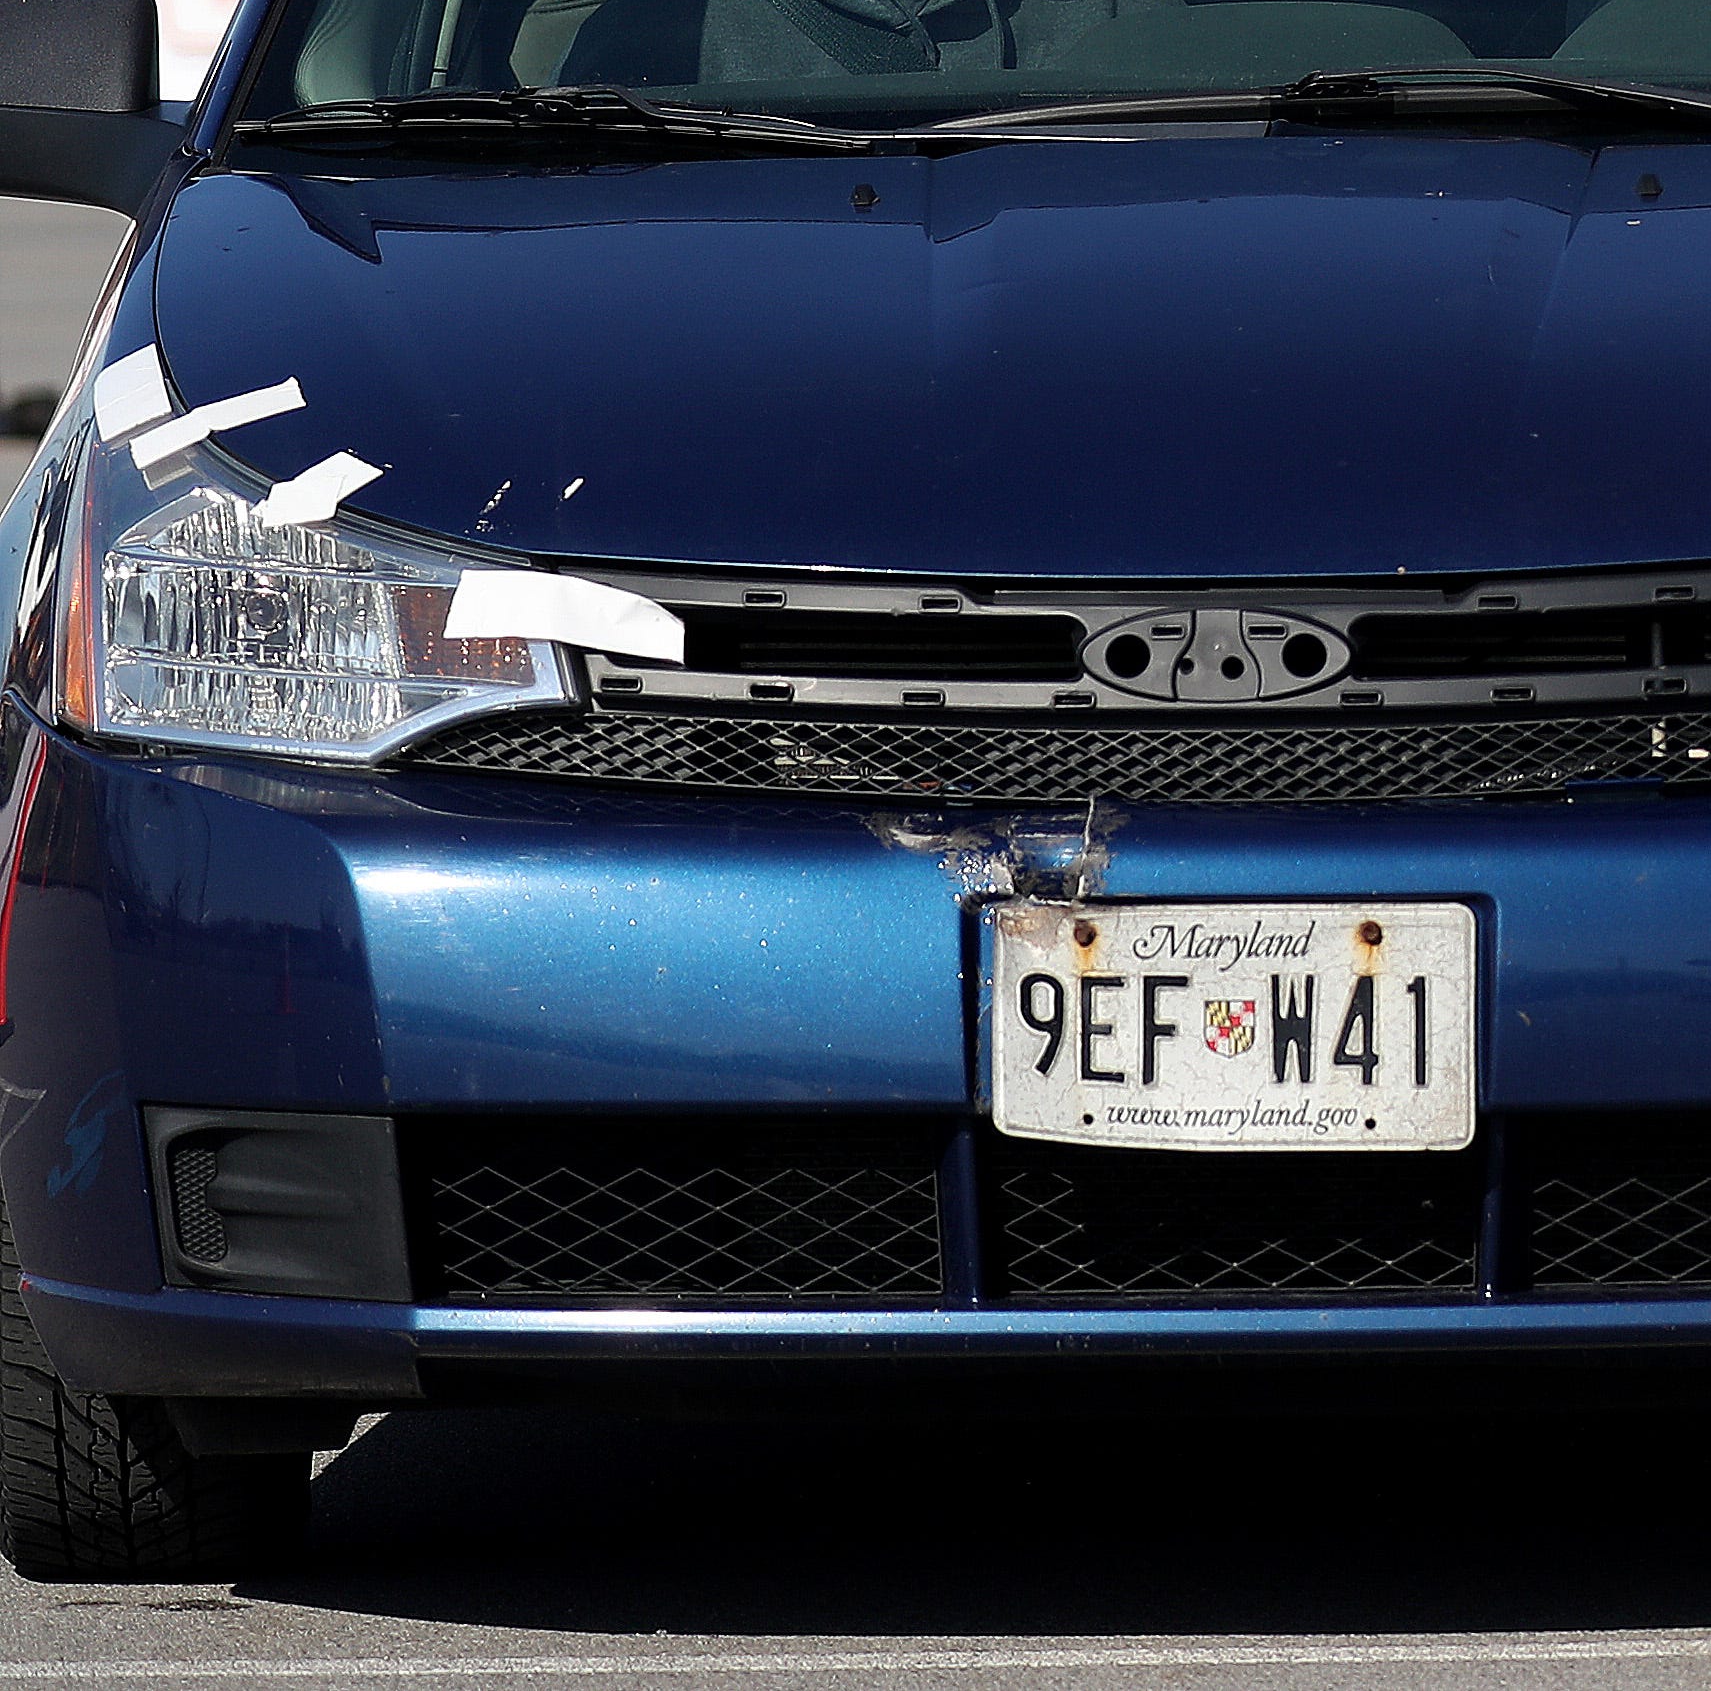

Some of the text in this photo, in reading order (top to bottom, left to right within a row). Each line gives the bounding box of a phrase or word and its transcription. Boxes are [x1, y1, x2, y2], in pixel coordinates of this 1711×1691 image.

[1133, 921, 1317, 971] Maryland
[1019, 973, 1428, 1086] 9EF W41
[1106, 1099, 1358, 1134] www.maryland.gov
